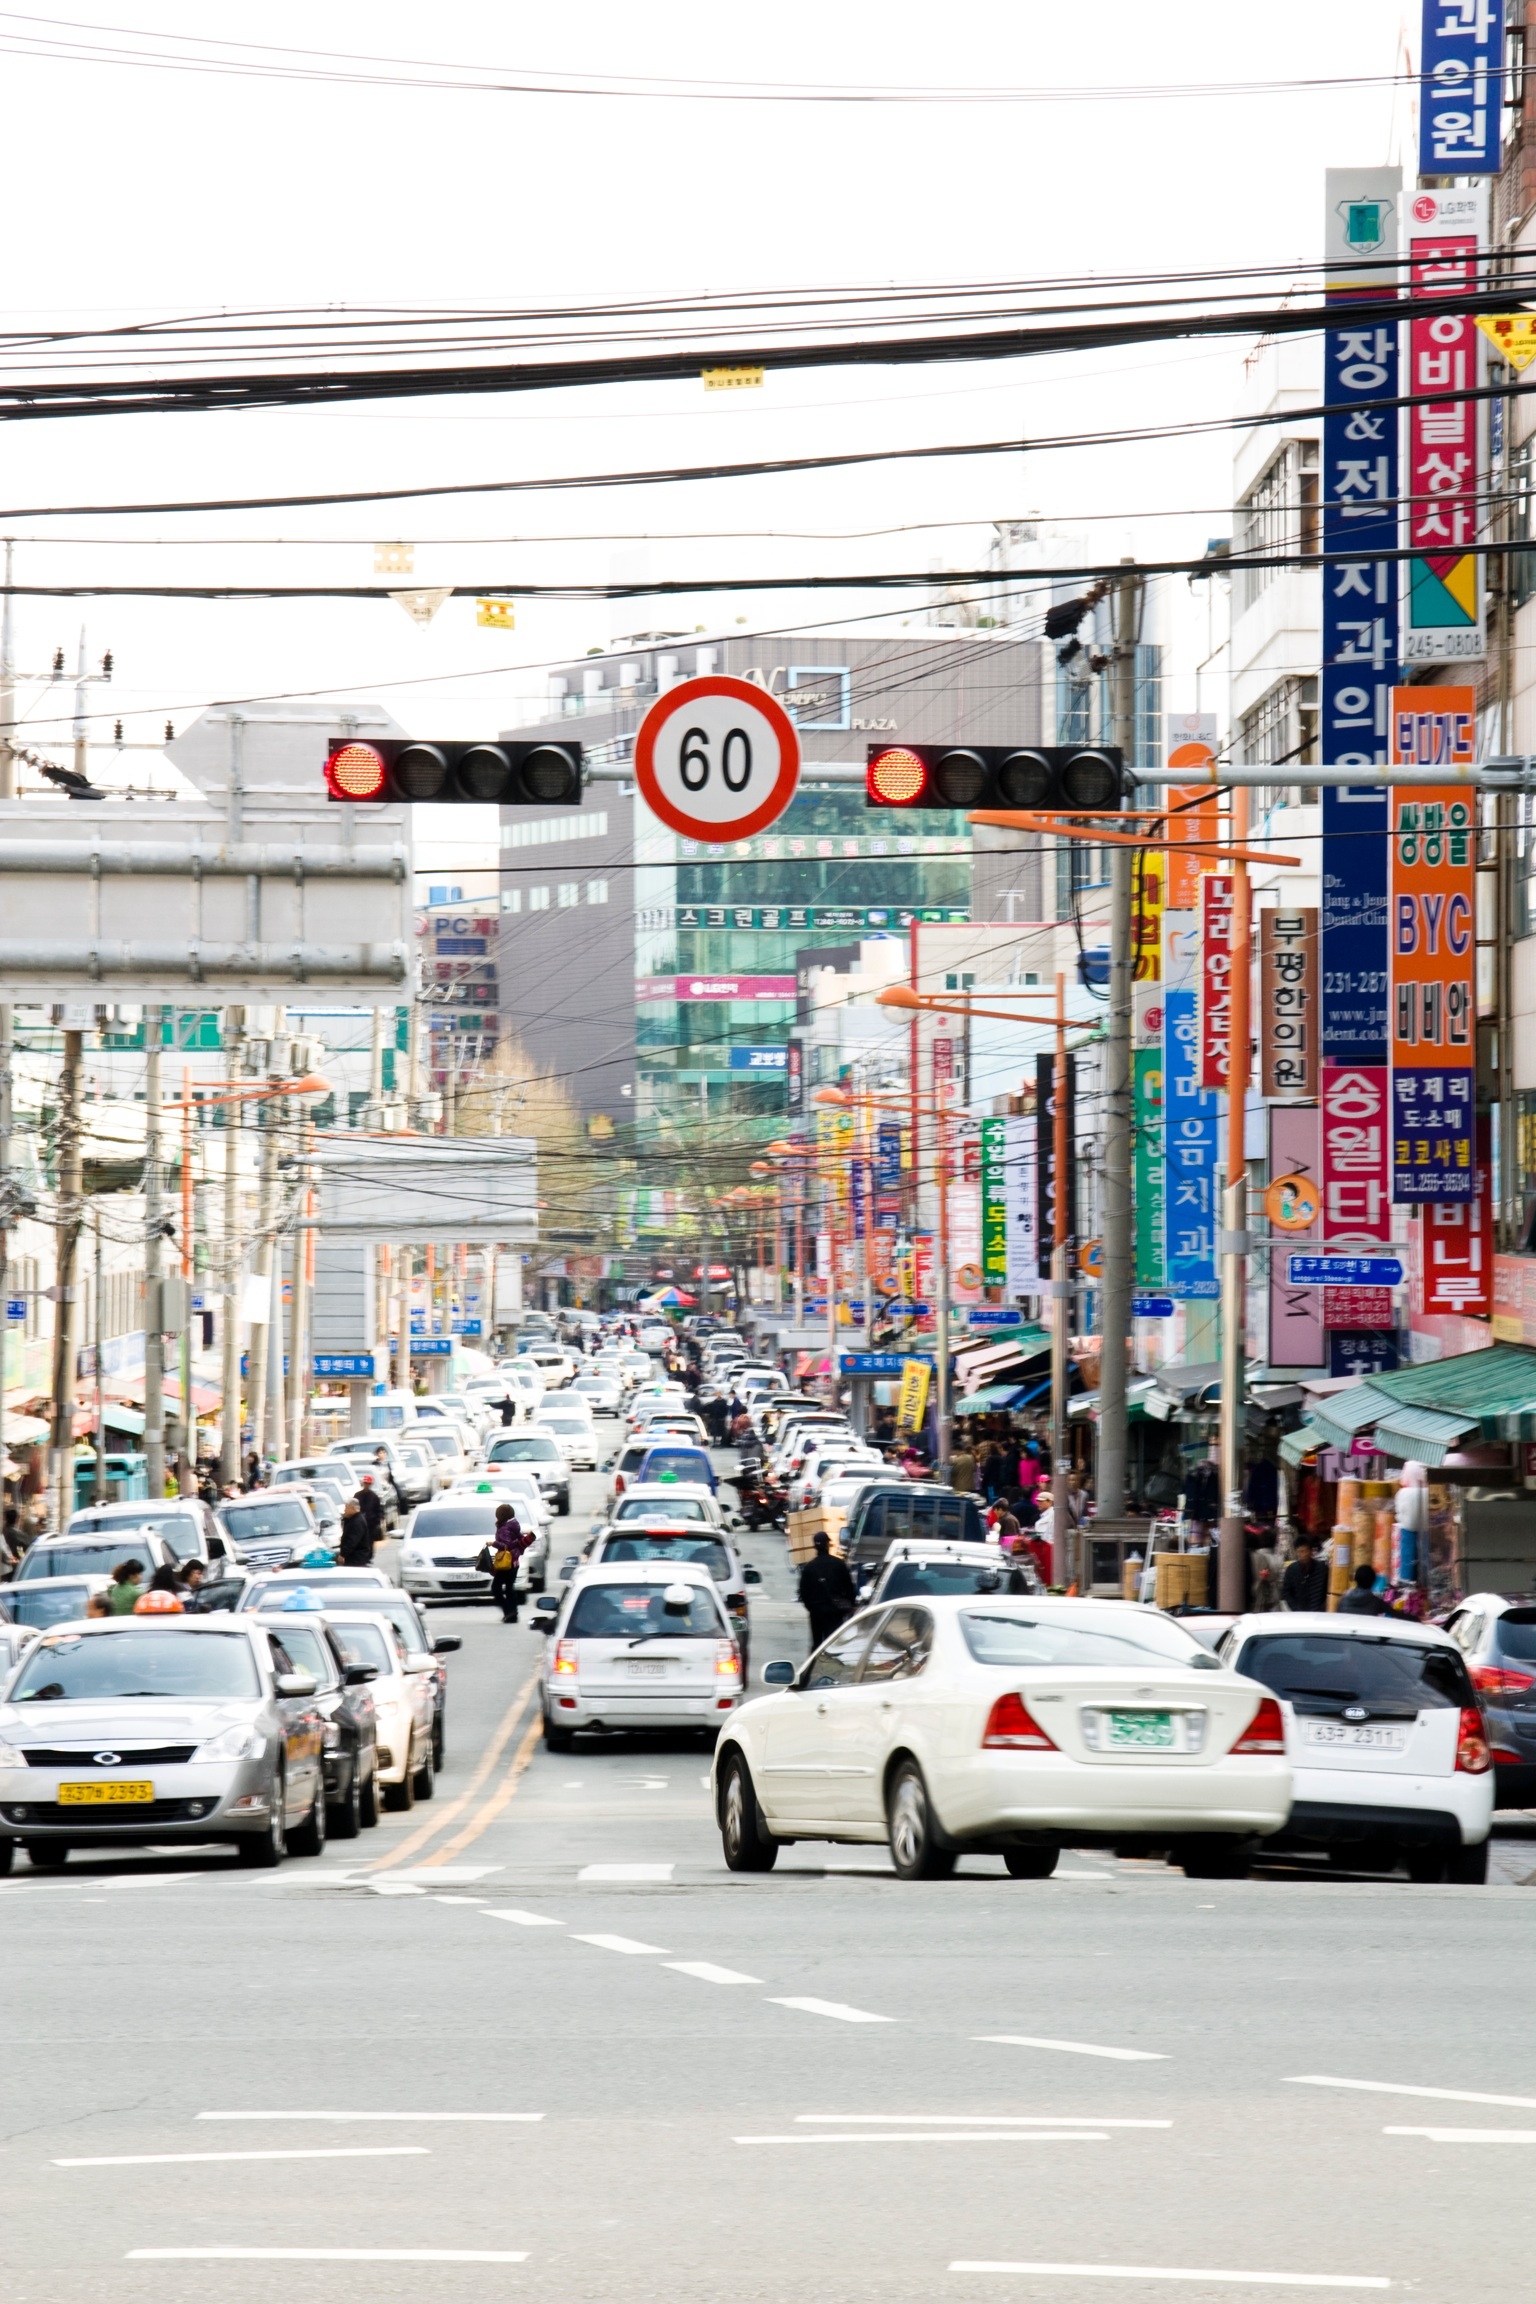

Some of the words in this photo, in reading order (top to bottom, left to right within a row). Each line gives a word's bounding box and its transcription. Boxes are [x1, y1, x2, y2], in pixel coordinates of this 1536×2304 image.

[1431, 0, 1498, 160] 과의원
[1334, 328, 1394, 517] 장&전
[1405, 634, 1482, 657] 245-0808
[852, 719, 898, 731] PLAZA
[679, 727, 753, 792] 60
[1397, 802, 1471, 868] 쌍방울
[1324, 874, 1345, 888] Dr.
[1324, 892, 1350, 910] Jang
[680, 907, 807, 928] 스크린골프
[1324, 911, 1362, 926] Dental
[1396, 892, 1471, 956] BYC
[1271, 916, 1310, 1089] 부평한의원
[1396, 980, 1471, 1046] 비비안
[1395, 1077, 1470, 1103] 란제리
[1395, 1138, 1470, 1167] 코코샤넬
[1429, 1199, 1487, 1311] 비니루
[1353, 1728, 1393, 1745] 2311
[107, 1784, 149, 1800] 2393
